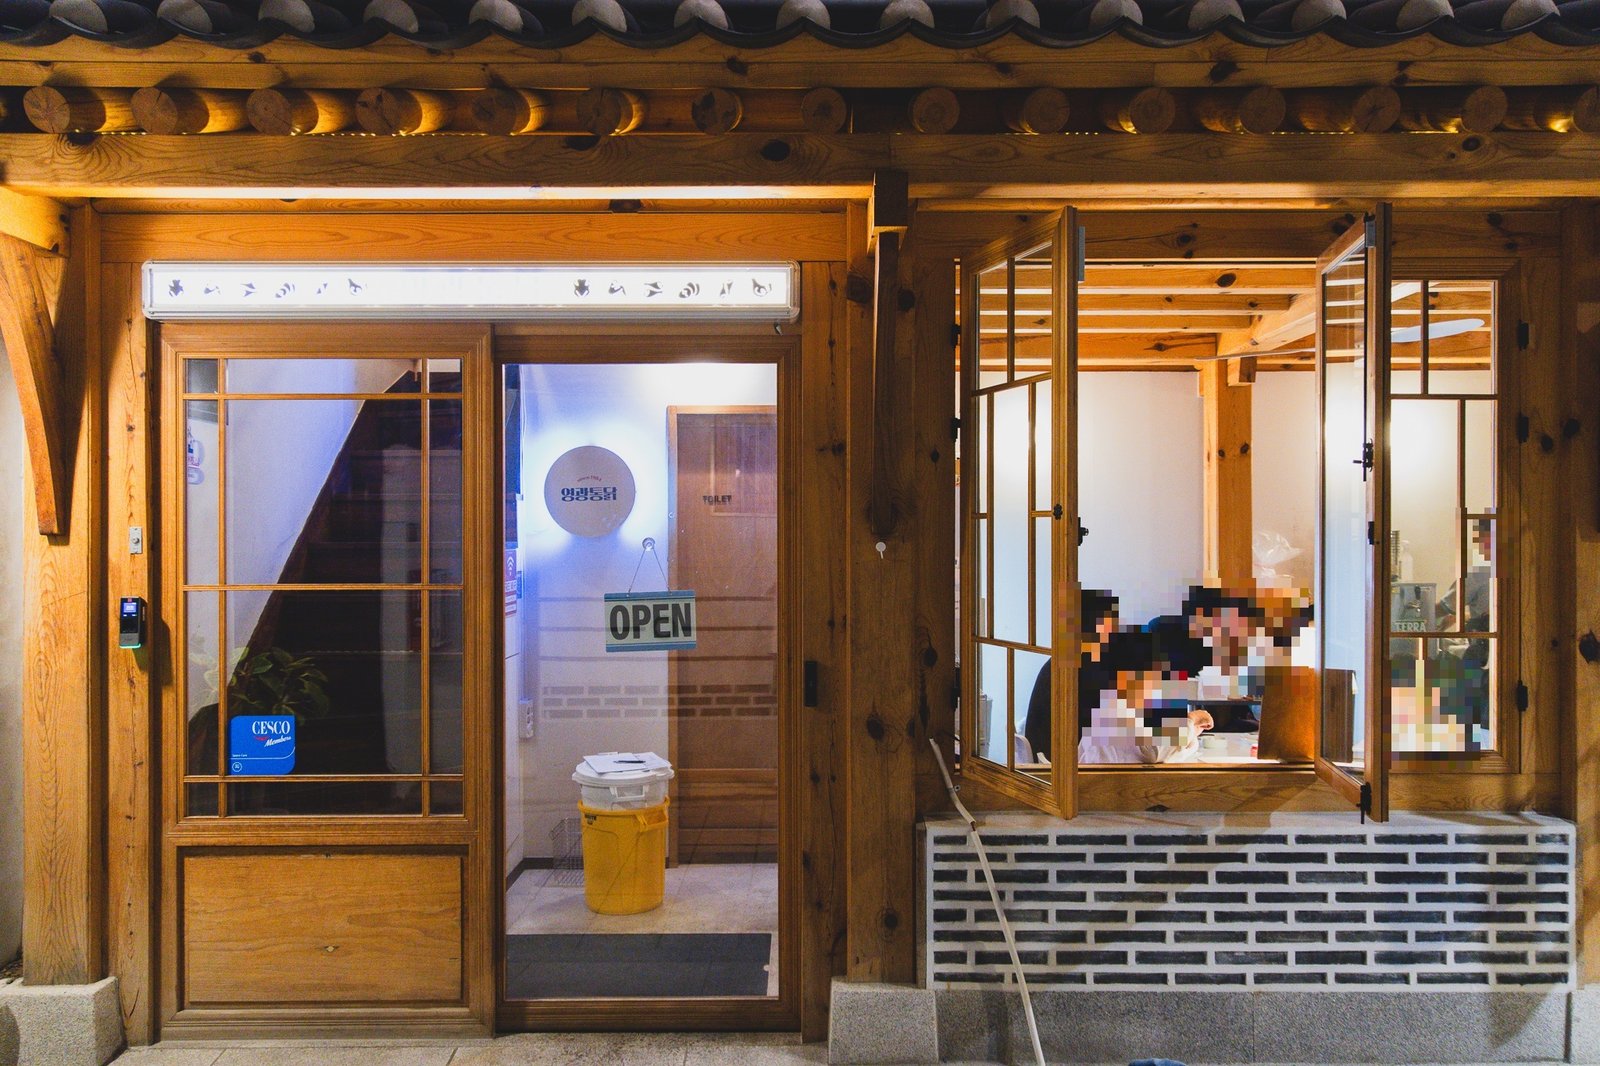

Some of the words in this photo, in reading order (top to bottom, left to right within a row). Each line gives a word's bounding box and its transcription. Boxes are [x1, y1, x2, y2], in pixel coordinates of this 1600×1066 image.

[561, 487, 617, 502] 영광통닭
[702, 494, 732, 505] TOILET
[609, 602, 692, 641] OPEN
[1394, 621, 1427, 632] TERRA
[251, 720, 291, 735] CESCO
